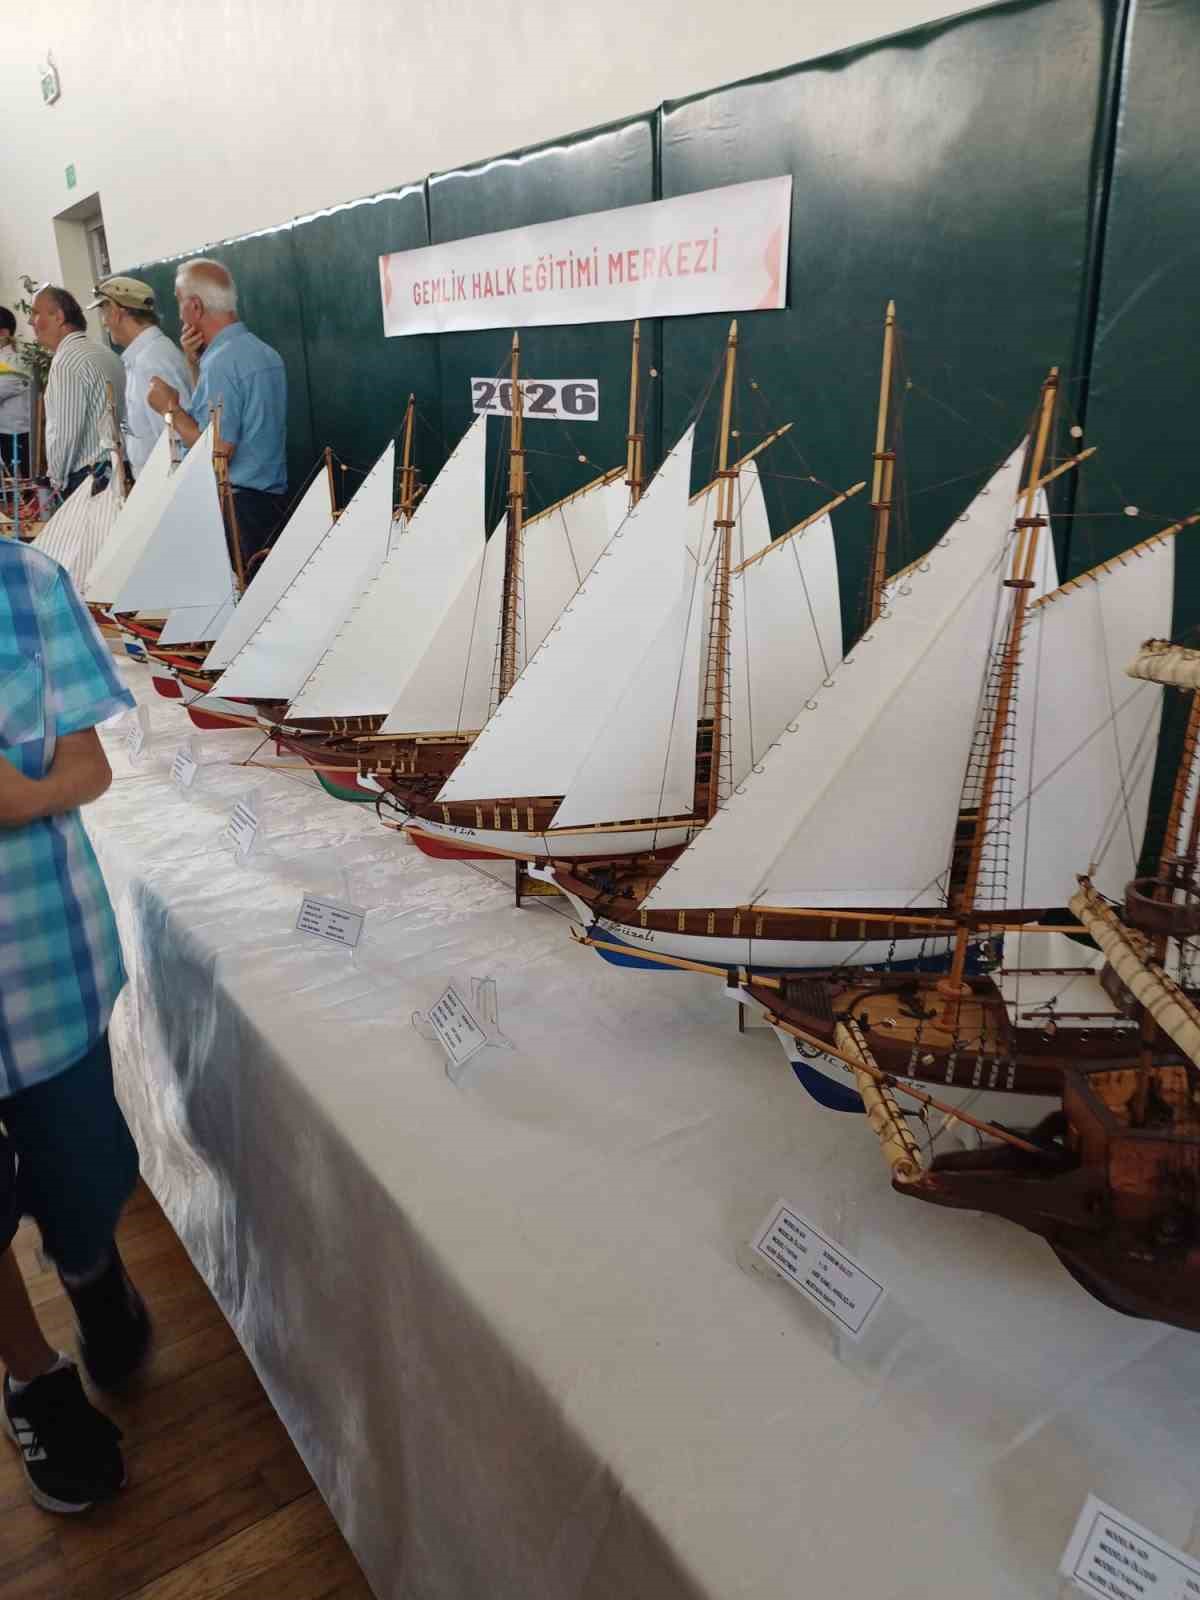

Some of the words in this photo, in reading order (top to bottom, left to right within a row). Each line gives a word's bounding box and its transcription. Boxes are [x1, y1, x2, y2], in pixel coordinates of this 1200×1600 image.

[413, 270, 466, 306] GEMLİK
[472, 267, 517, 299] HALK
[522, 246, 599, 293] EĞİTİMİ
[608, 227, 719, 285] MERKEZİ
